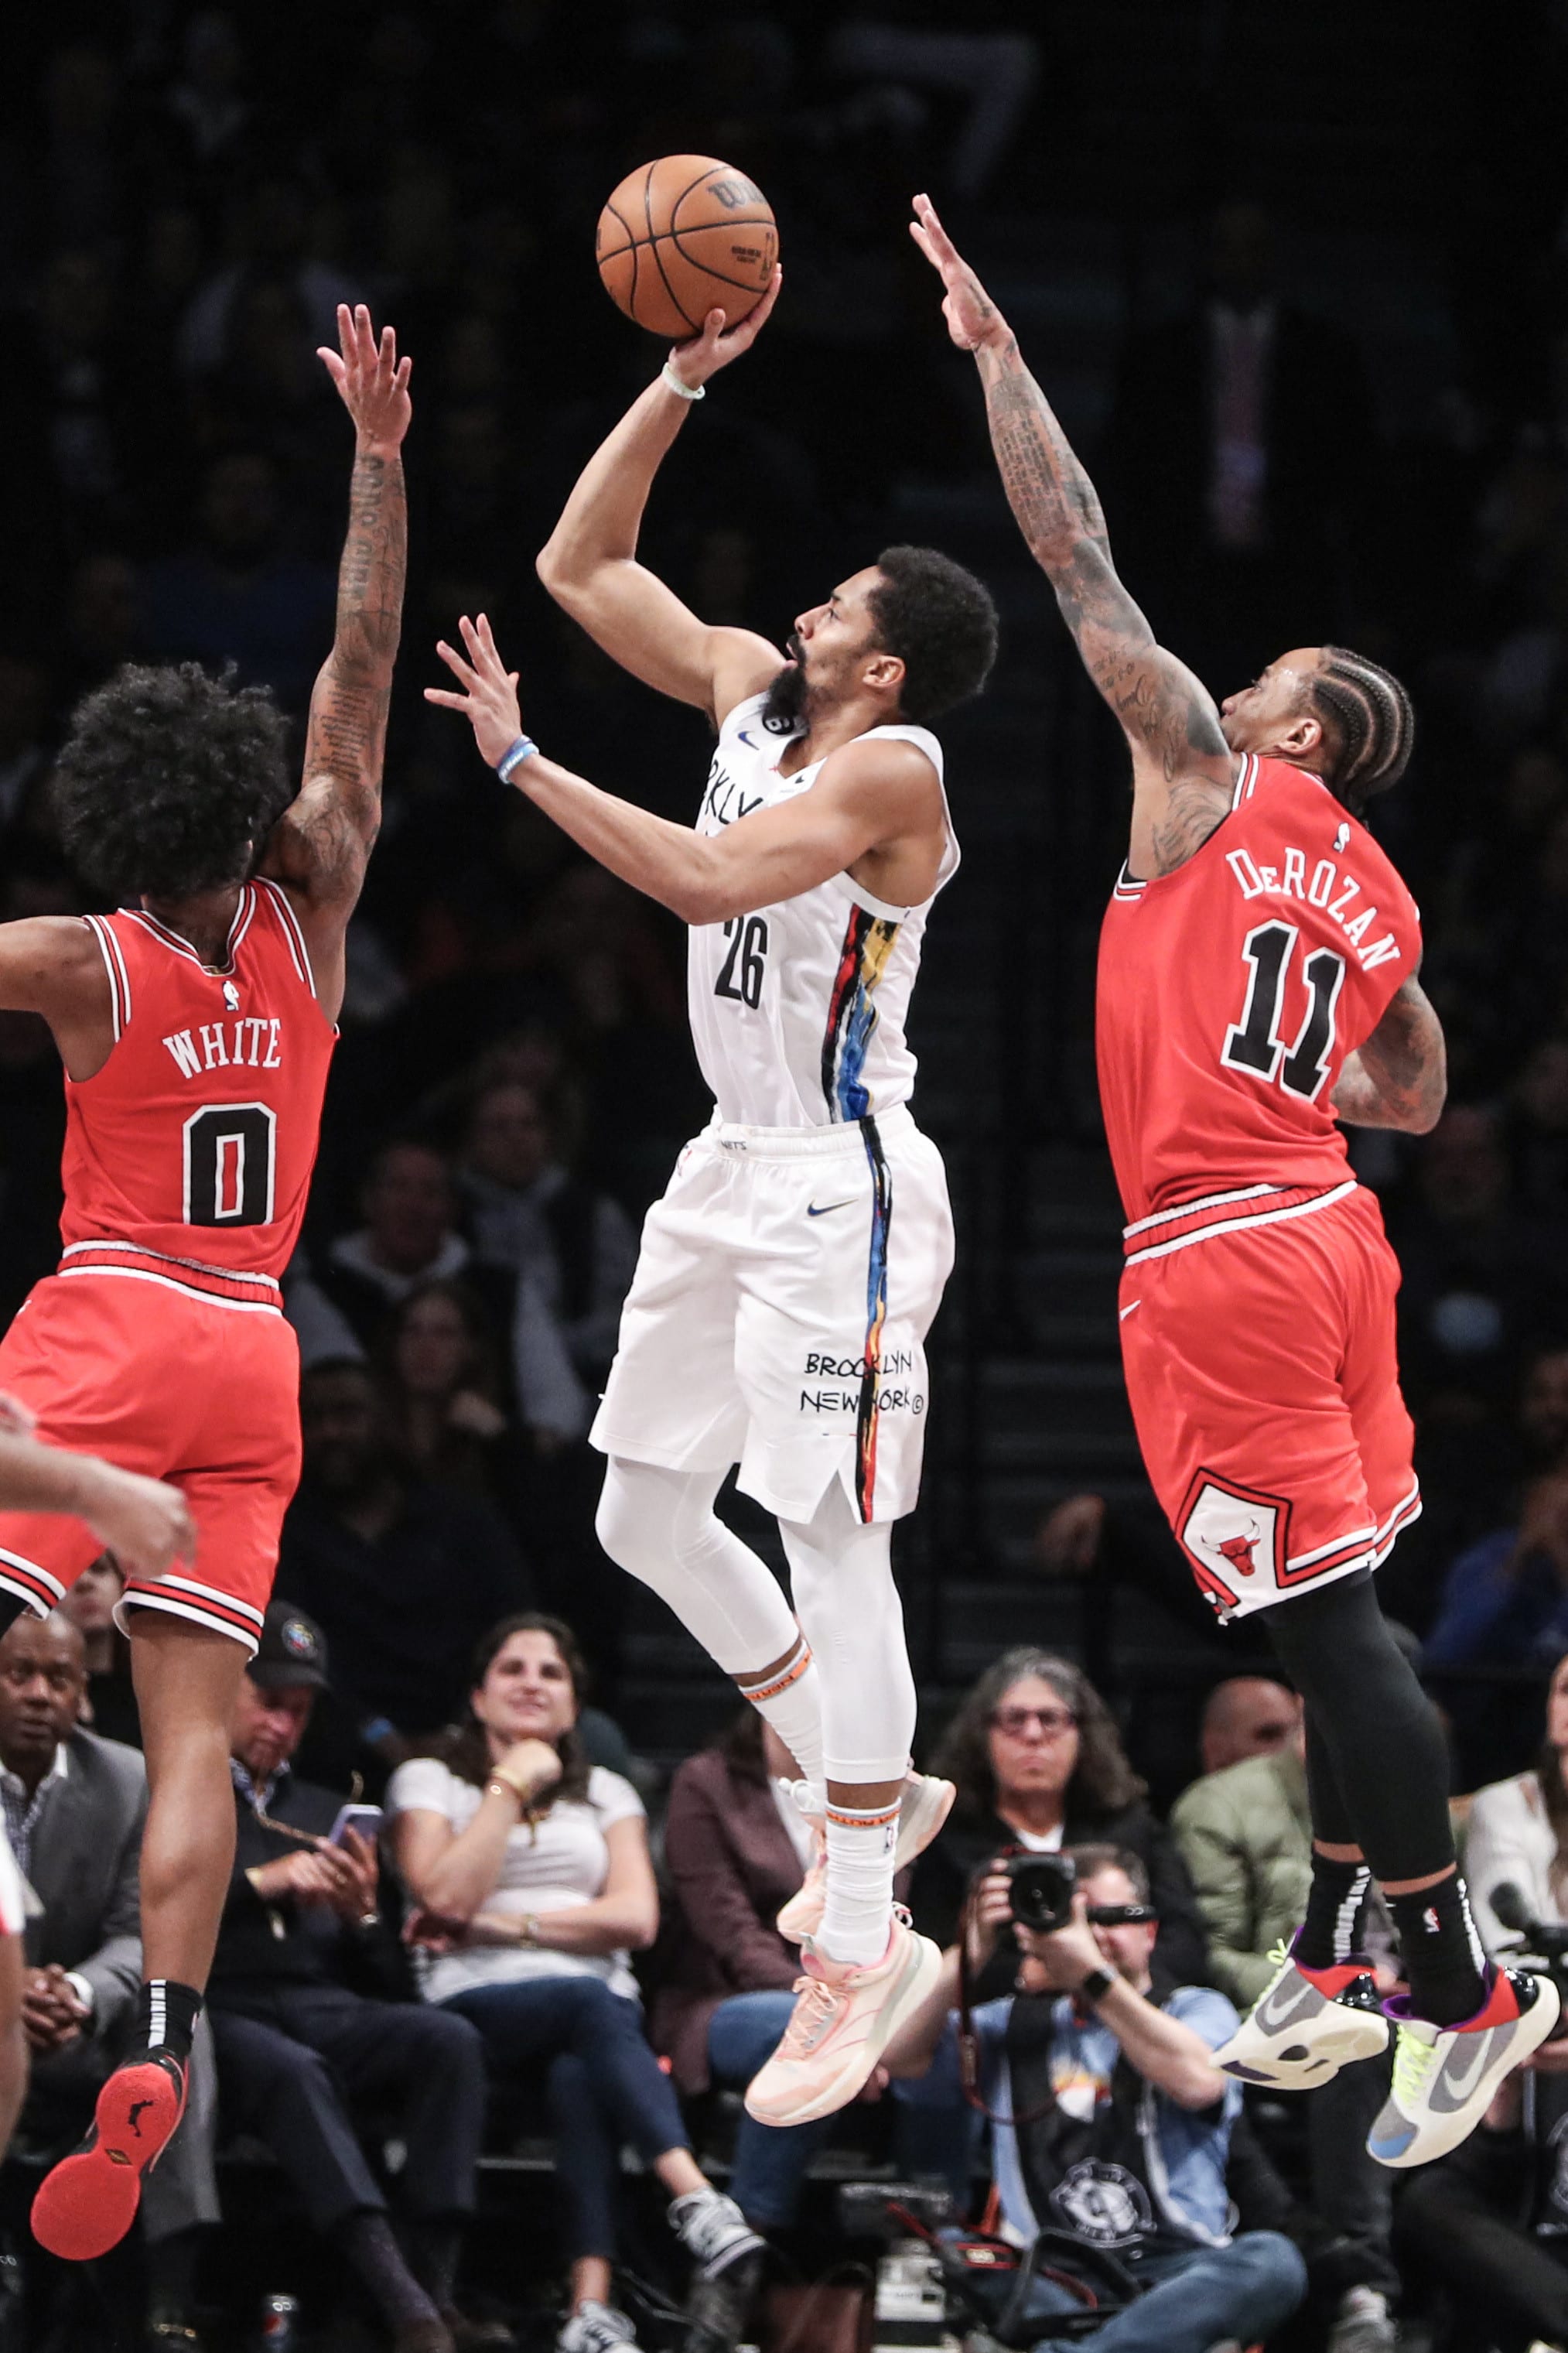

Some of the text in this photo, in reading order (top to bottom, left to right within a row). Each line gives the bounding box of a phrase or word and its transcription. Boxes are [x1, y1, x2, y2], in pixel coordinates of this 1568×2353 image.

[705, 759, 764, 826] KLY
[714, 916, 767, 1010] 26
[1220, 918, 1345, 1103] 11
[162, 1017, 282, 1079] WHITE
[183, 1102, 277, 1226] 0
[804, 1349, 912, 1377] BROOKLYN
[801, 1390, 860, 1413] NEW
